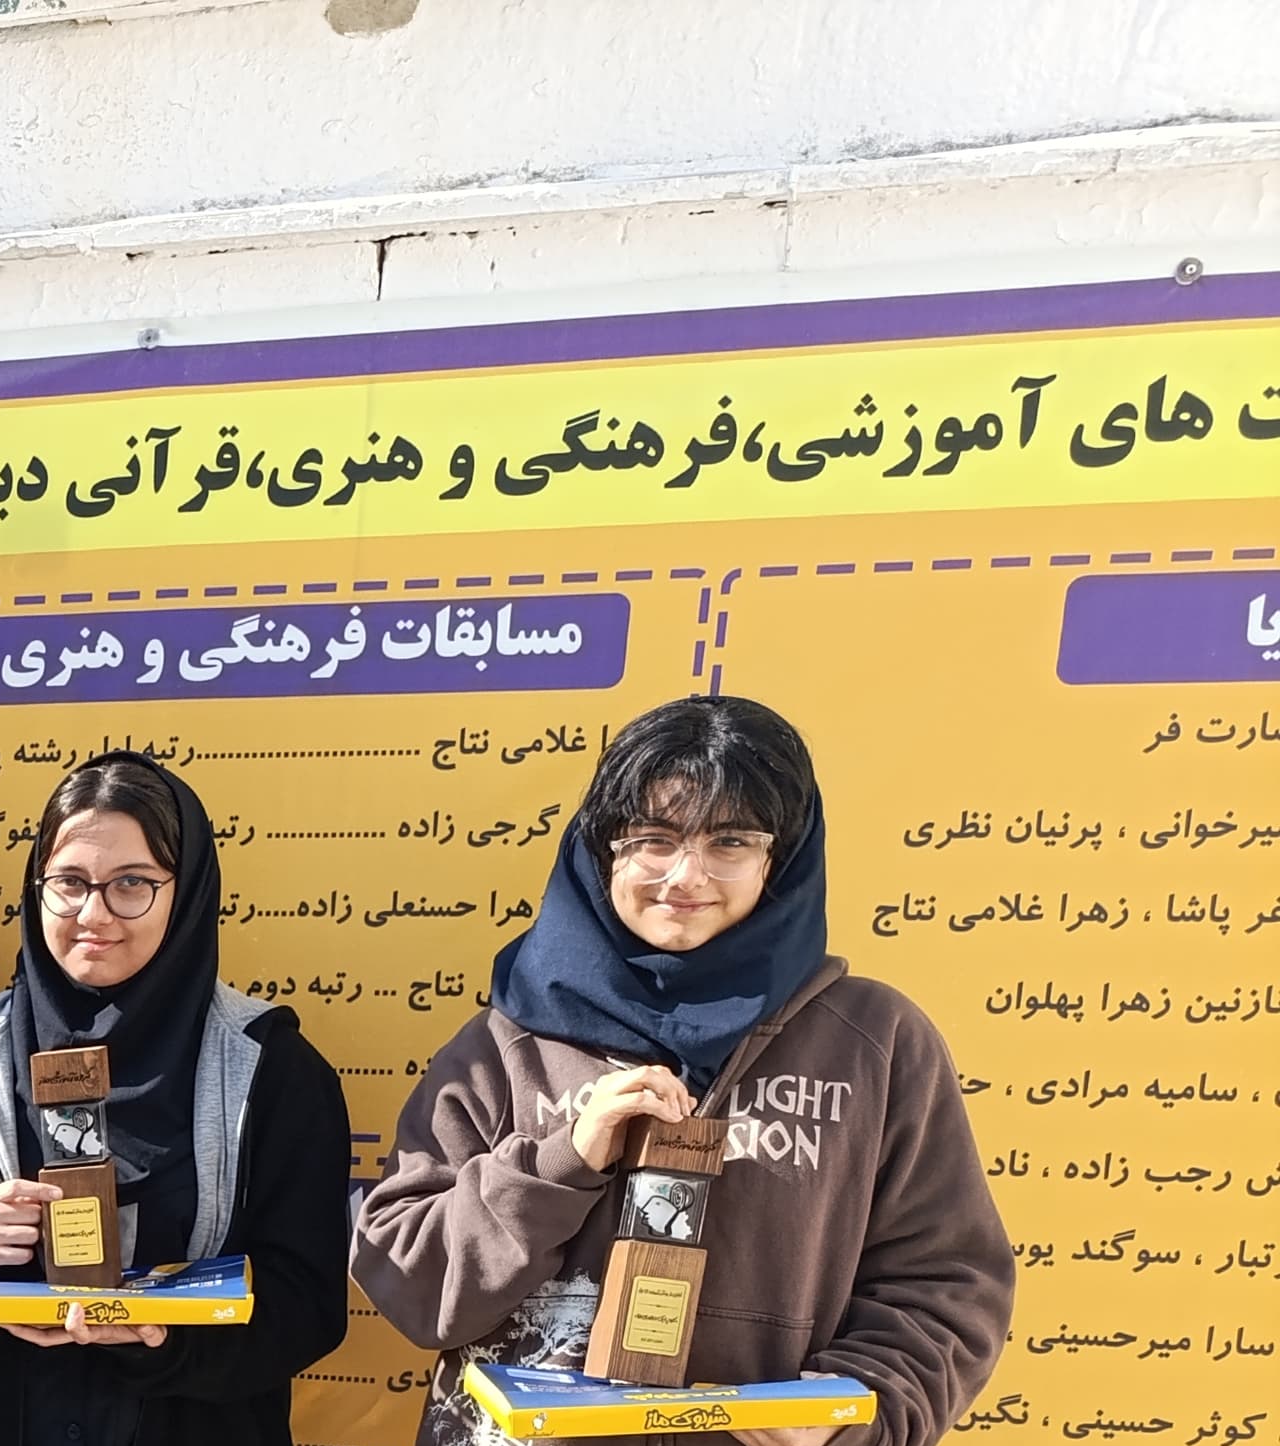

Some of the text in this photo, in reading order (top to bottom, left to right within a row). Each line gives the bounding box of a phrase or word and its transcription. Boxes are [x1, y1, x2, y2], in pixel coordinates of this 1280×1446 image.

[1069, 375, 1214, 468] های
[440, 443, 474, 500] و
[0, 603, 584, 689] مسابقات فرهنگی و هنری
[13, 738, 78, 770] رشته
[431, 731, 490, 772] نتاج
[500, 725, 587, 770] غلامی
[1142, 712, 1182, 754] فر
[211, 803, 560, 847] گرجی زاده رتب
[902, 808, 1280, 851] یرخوانی پرنیان نظری
[296, 888, 535, 928] هرا حسنعلی زاده
[870, 892, 1231, 937] پاشا زهرا غلامی نتاج
[245, 970, 465, 1012] نتاج رتبه دوم
[984, 981, 1085, 1023] پهلوان
[1100, 982, 1172, 1022] زهرا
[1025, 1069, 1238, 1110] سامیه مرادی
[1063, 1152, 1232, 1193] رجب زاده
[1070, 1228, 1181, 1273] سوگند
[1026, 1321, 1275, 1361] سارا میرحسینی
[1062, 1406, 1174, 1441] حسینی
